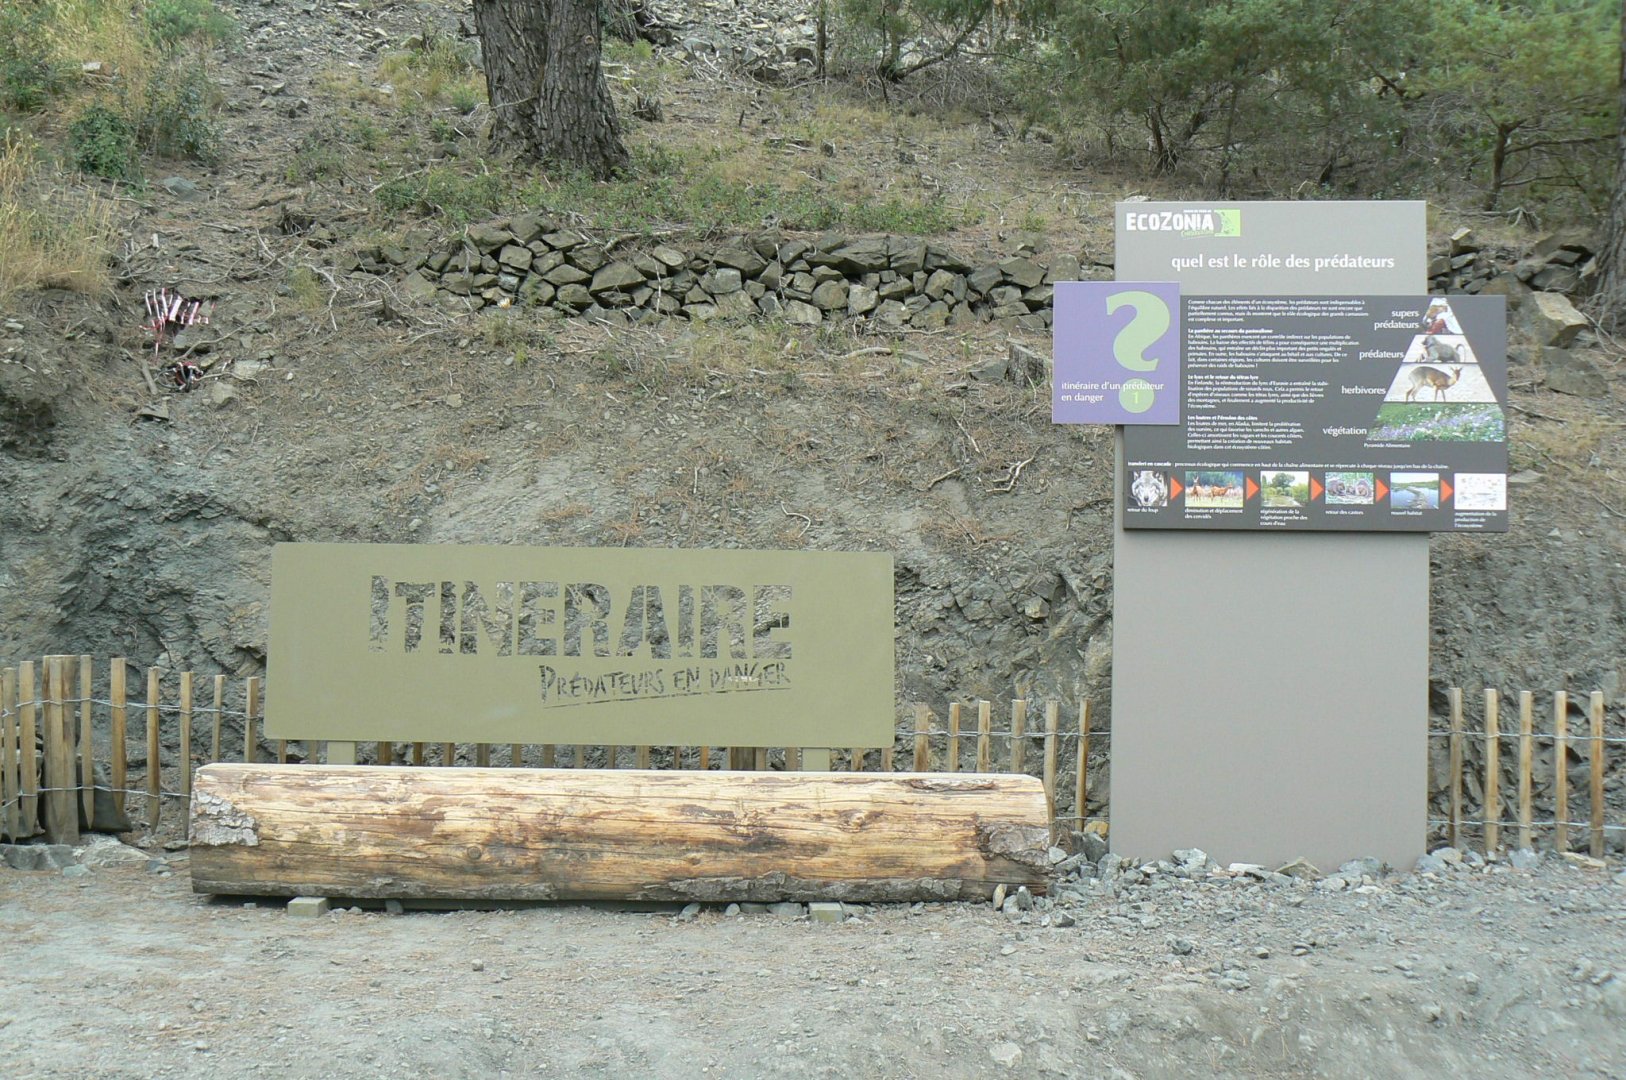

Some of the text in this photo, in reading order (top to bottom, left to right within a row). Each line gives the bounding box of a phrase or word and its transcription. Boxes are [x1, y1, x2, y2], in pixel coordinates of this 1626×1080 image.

[1171, 253, 1395, 272] quel est le rôle des prédateurs
[1392, 310, 1420, 320] supers
[1374, 320, 1420, 331] prédateurs
[1359, 350, 1404, 360] prédateurs
[1061, 380, 1164, 392] itinéraire d'un prédateur
[1341, 385, 1386, 395] herbivores
[1074, 392, 1104, 404] danger
[1322, 426, 1368, 438] végétation
[368, 574, 793, 660] ITINERAIRE
[673, 666, 700, 692] EN
[709, 661, 791, 689] DANGER
